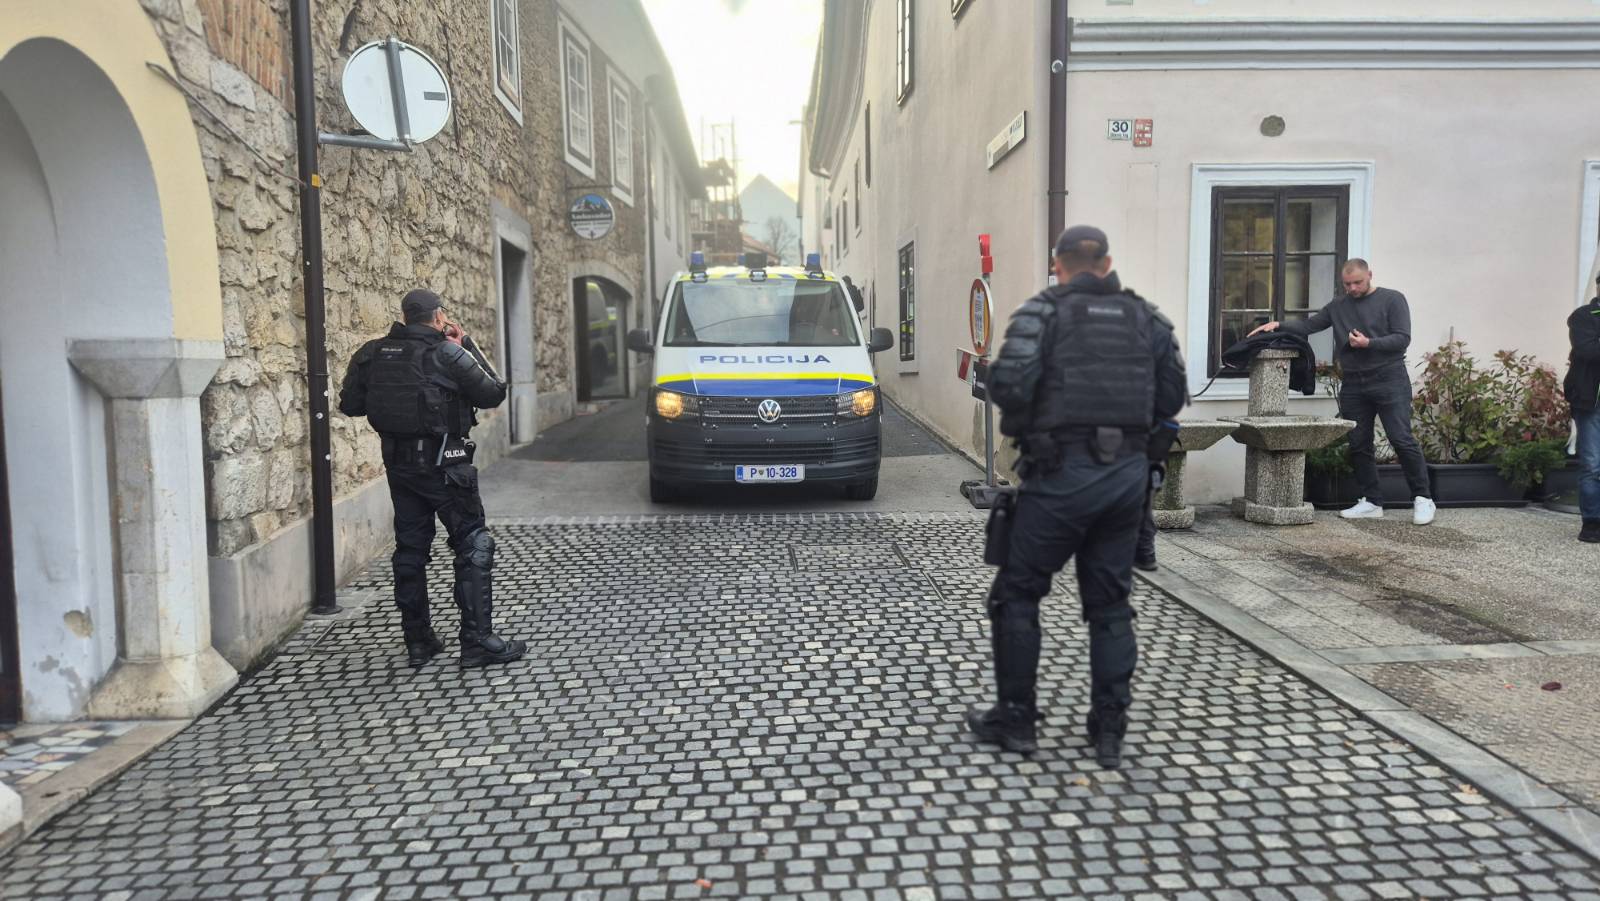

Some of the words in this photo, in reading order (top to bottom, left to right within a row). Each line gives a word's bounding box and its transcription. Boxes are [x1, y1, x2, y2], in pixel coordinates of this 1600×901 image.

[1112, 121, 1129, 132] 30
[700, 355, 831, 364] POLICIJA
[750, 468, 758, 478] P
[766, 467, 797, 478] 10-328
